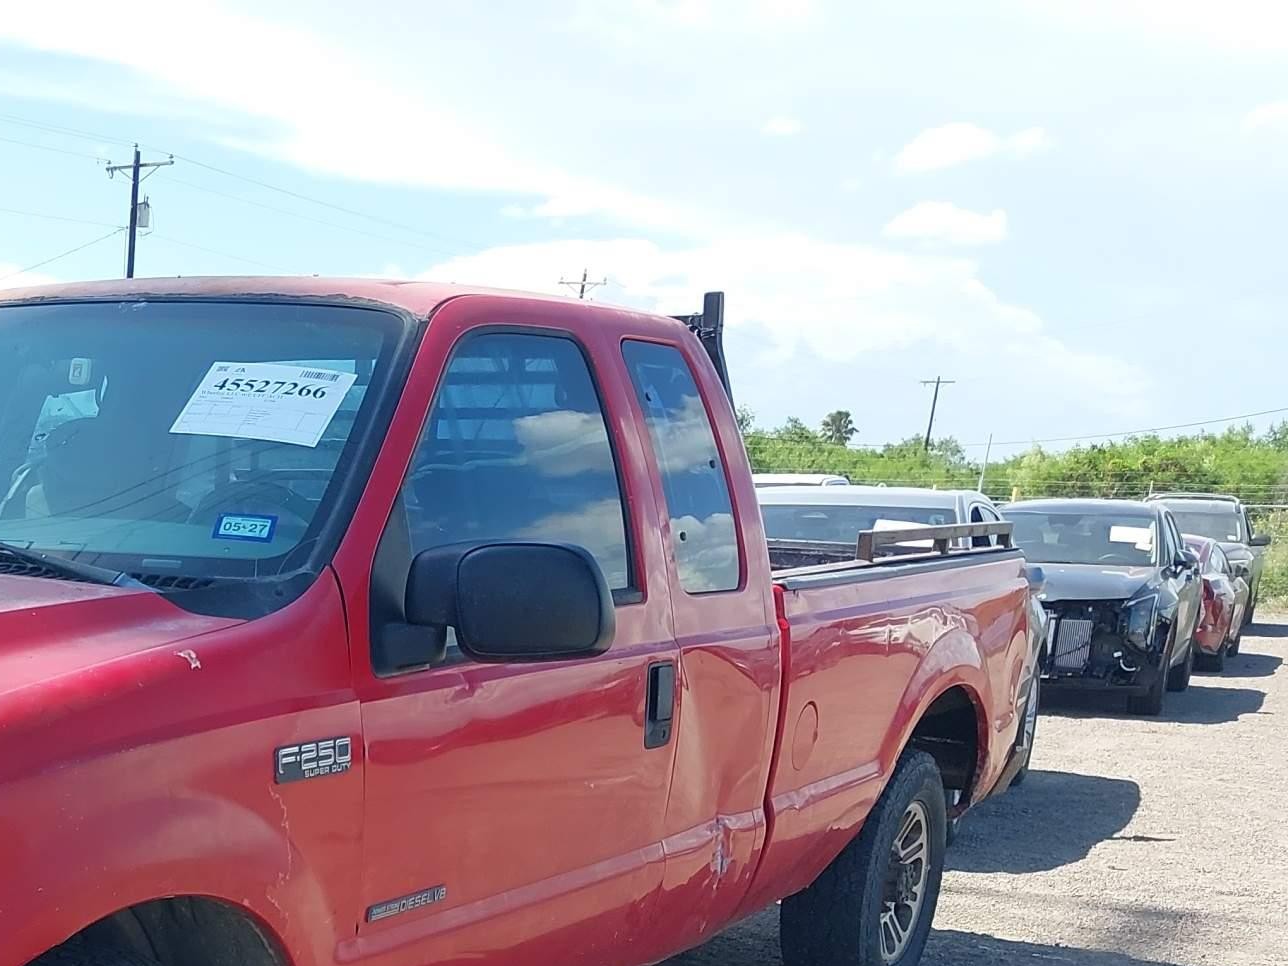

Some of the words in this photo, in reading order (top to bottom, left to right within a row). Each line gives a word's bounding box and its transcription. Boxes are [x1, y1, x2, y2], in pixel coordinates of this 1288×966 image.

[214, 377, 329, 399] 45527266
[304, 766, 330, 778] SUPER
[331, 762, 352, 773] DUTY
[399, 892, 433, 913] DIESEL
[434, 887, 447, 901] V8
